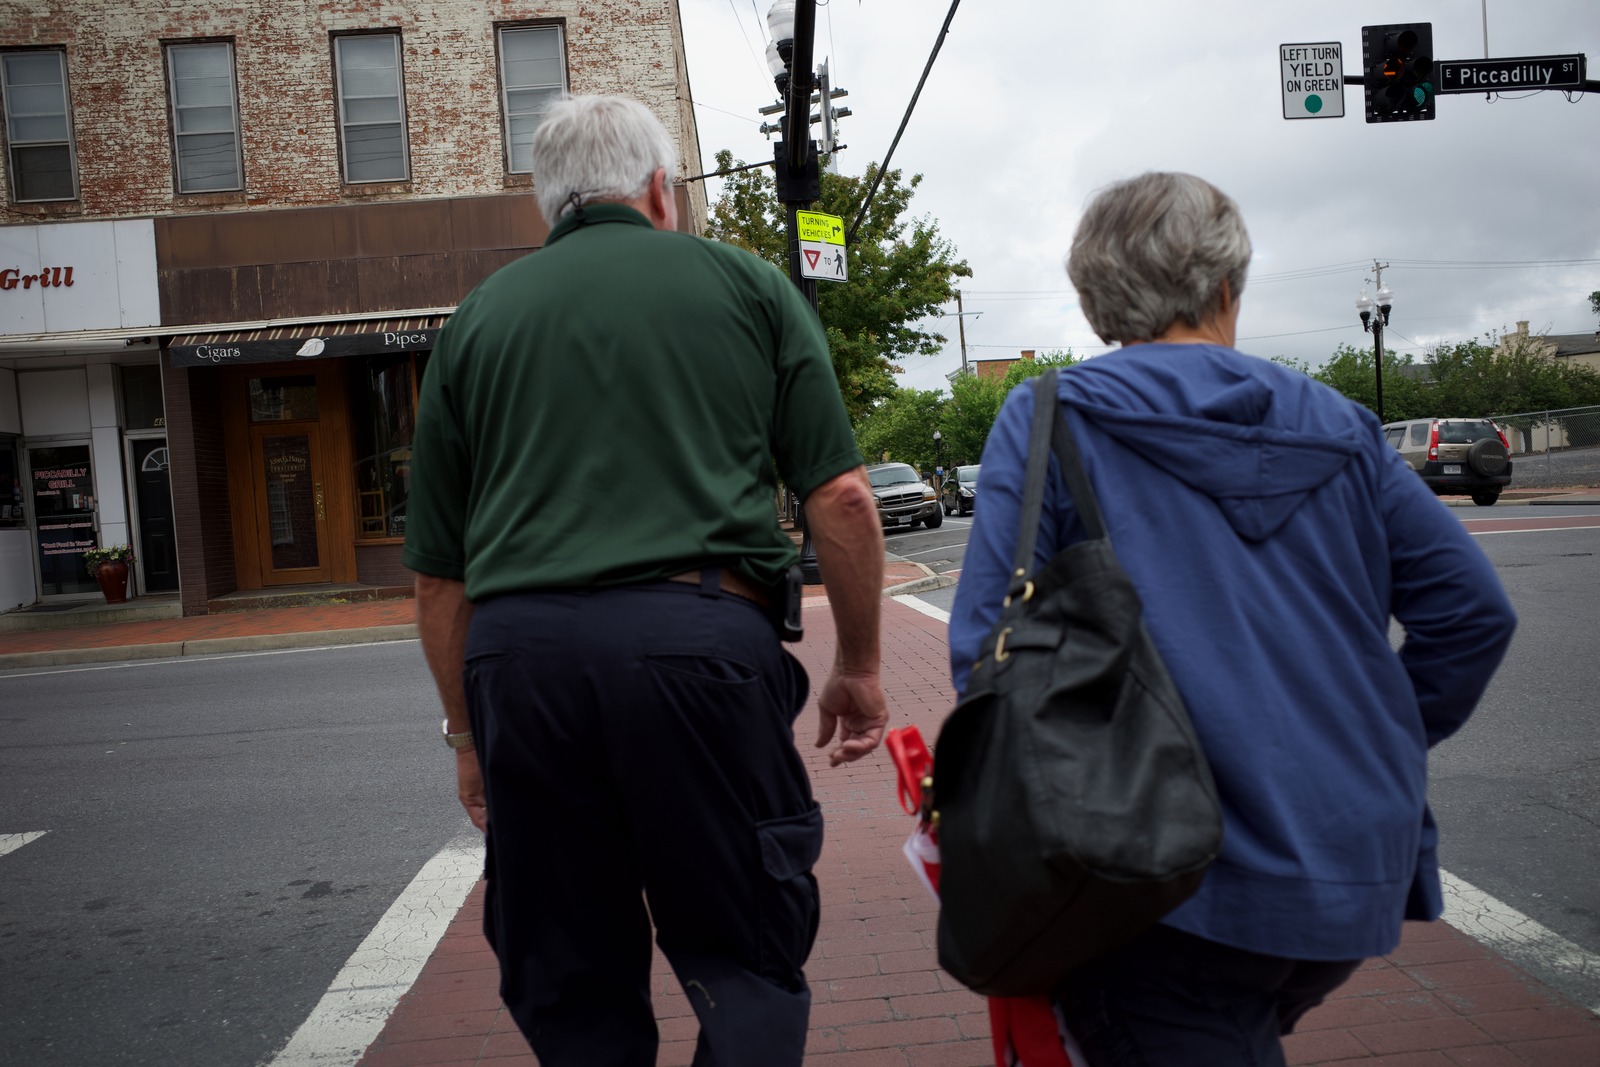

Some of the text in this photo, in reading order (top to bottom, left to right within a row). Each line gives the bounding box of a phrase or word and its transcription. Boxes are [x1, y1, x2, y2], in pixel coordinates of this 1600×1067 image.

[1283, 47, 1339, 61] LEFT TURN
[1289, 62, 1334, 77] YIELD
[1446, 62, 1574, 85] E Piccadilly ST
[1286, 79, 1339, 92] ON GREEN
[802, 217, 829, 227] TURNING
[802, 229, 831, 239] VEHICLES
[824, 257, 831, 266] TO
[0, 266, 74, 290] Grill
[383, 331, 427, 349] Pipes
[196, 344, 241, 363] Cigars
[34, 468, 87, 480] PICCADILLY
[48, 479, 76, 489] GRILL
